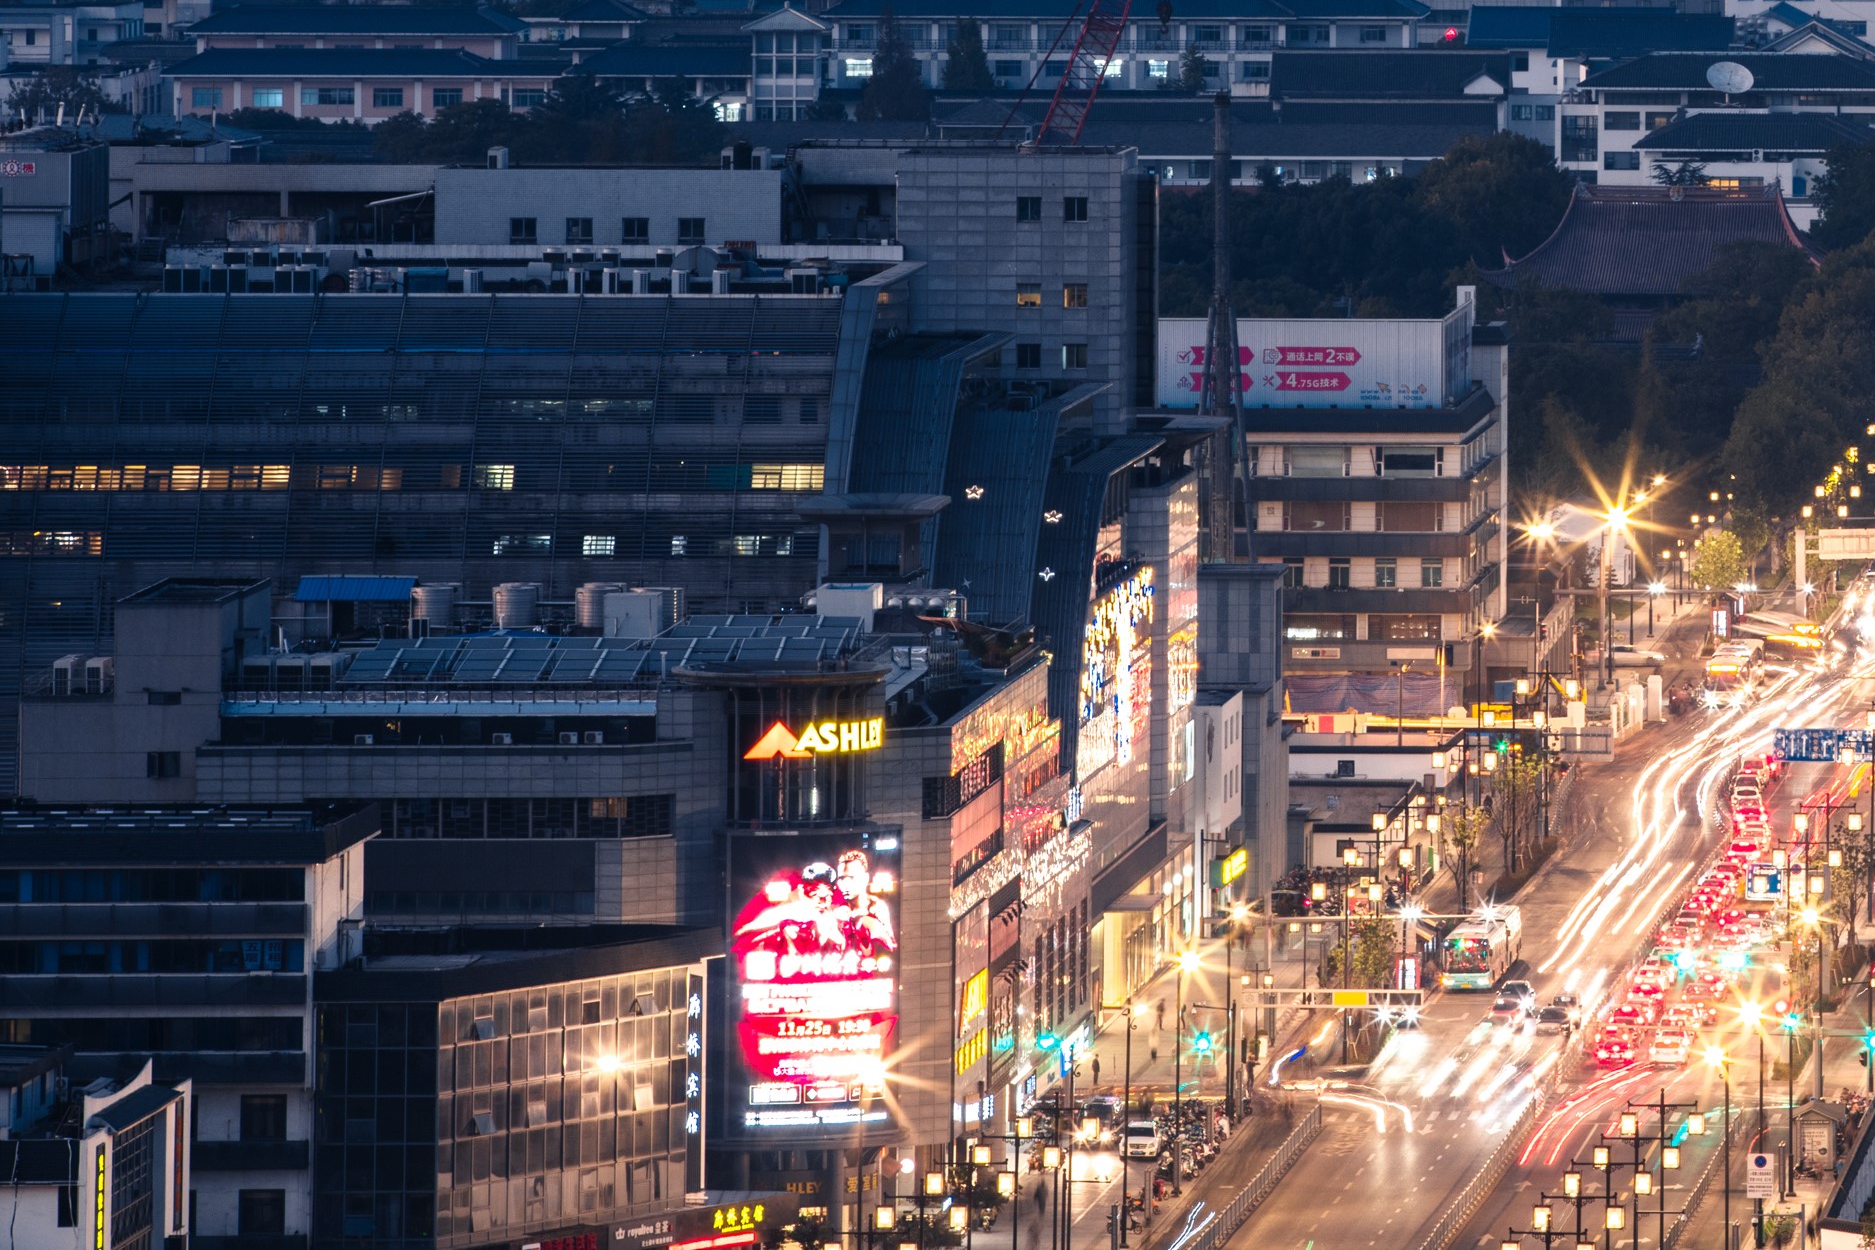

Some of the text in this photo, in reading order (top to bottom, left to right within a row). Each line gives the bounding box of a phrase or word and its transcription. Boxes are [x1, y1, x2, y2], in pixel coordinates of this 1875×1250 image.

[1286, 349, 1355, 363] 通话上网2不误
[1285, 373, 1340, 388] 4.75G技术
[793, 717, 883, 752] ASHLEY
[713, 1204, 765, 1229] 廊桥宾馆
